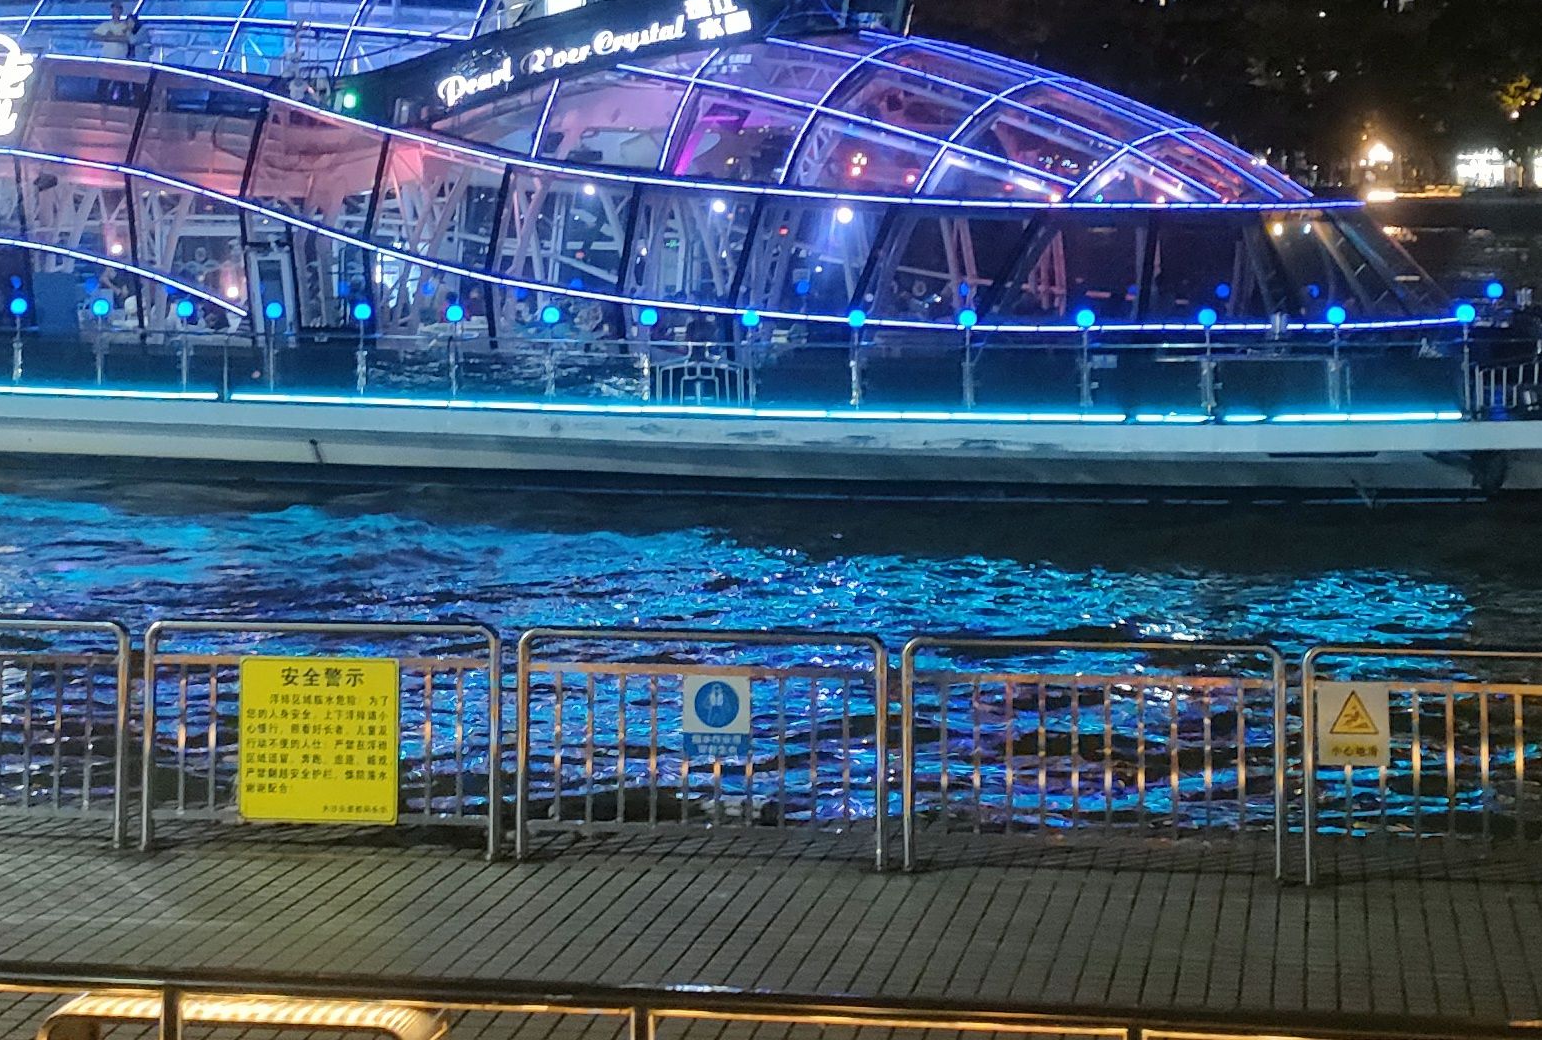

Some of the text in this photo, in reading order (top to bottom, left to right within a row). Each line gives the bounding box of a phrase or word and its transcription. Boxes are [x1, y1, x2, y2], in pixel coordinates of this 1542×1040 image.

[437, 56, 515, 107] Pearl
[593, 14, 687, 56] Crystal
[281, 666, 365, 687] 安全警示
